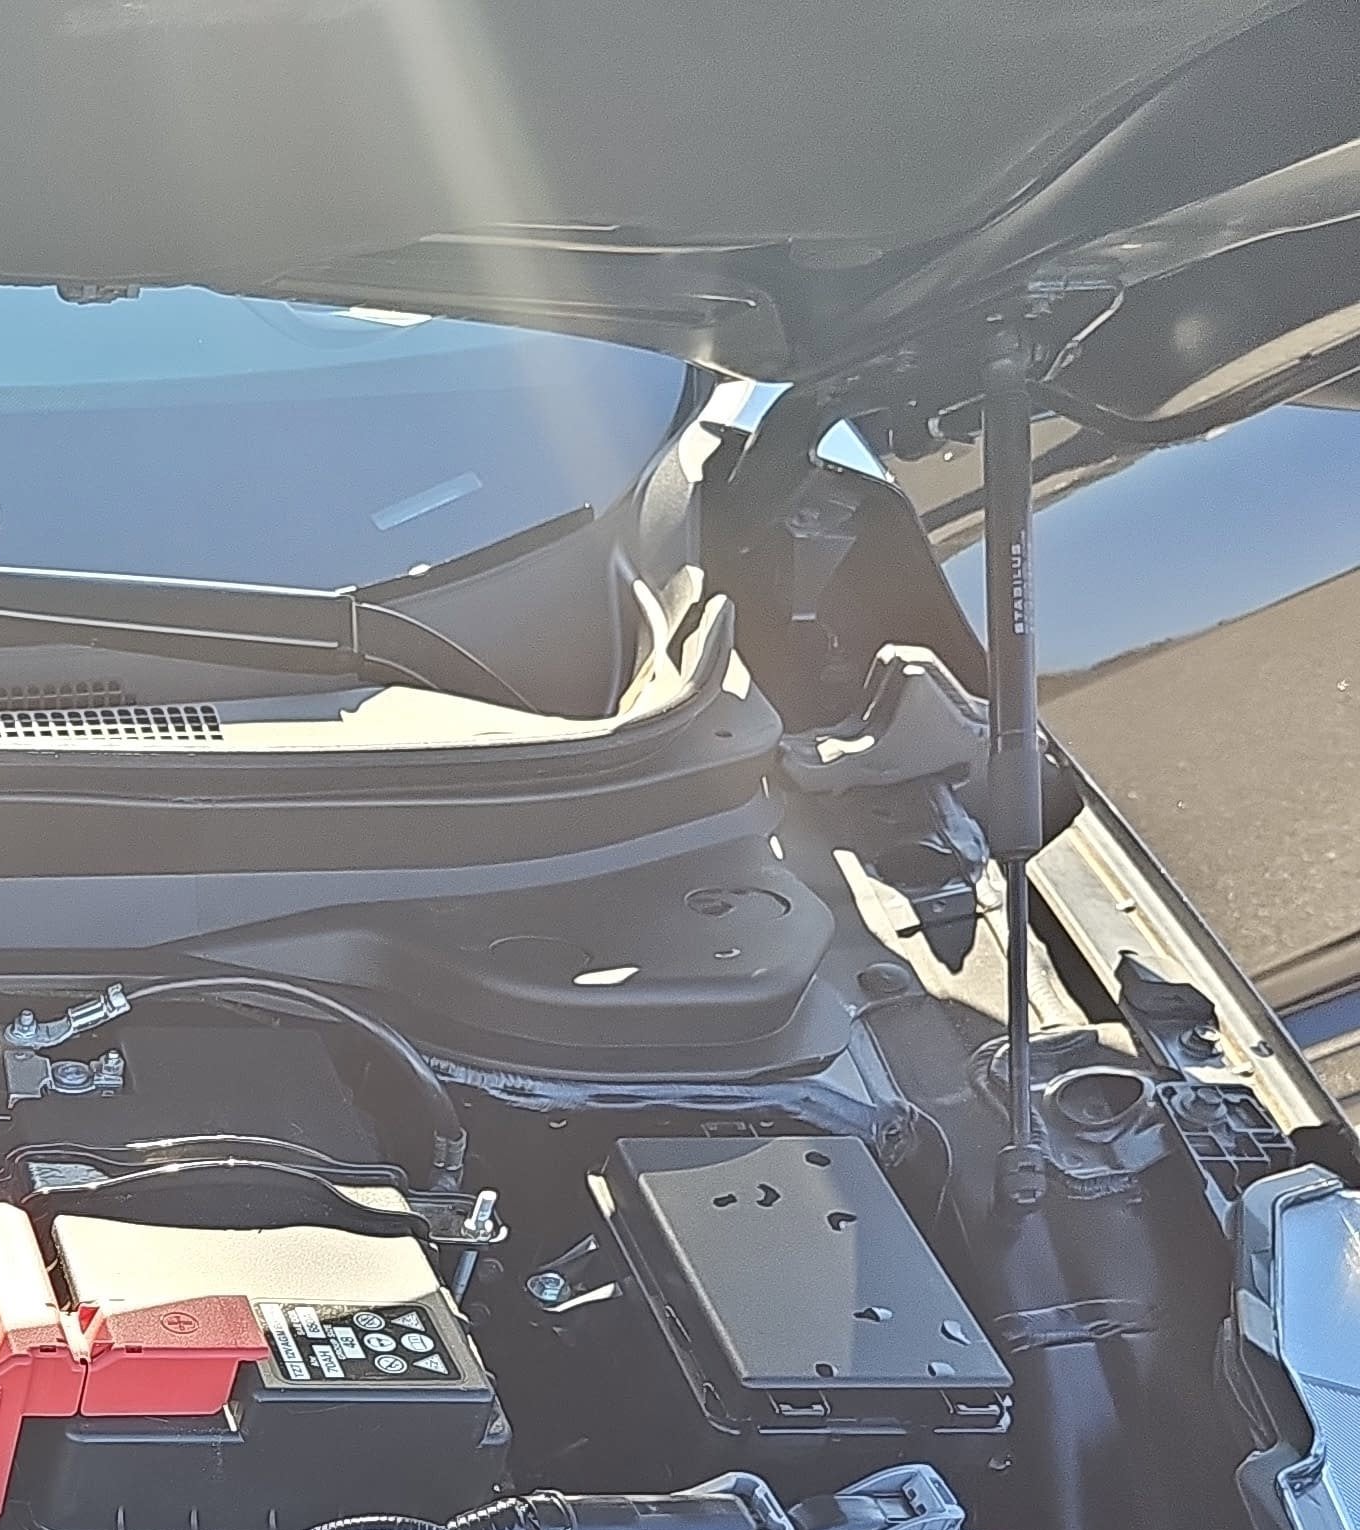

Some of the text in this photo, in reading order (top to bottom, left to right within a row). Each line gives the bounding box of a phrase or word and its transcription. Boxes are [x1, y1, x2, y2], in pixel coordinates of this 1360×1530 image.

[1011, 543, 1024, 634] STABILUS
[340, 1336, 356, 1348] 48
[318, 1351, 338, 1372] 70AH
